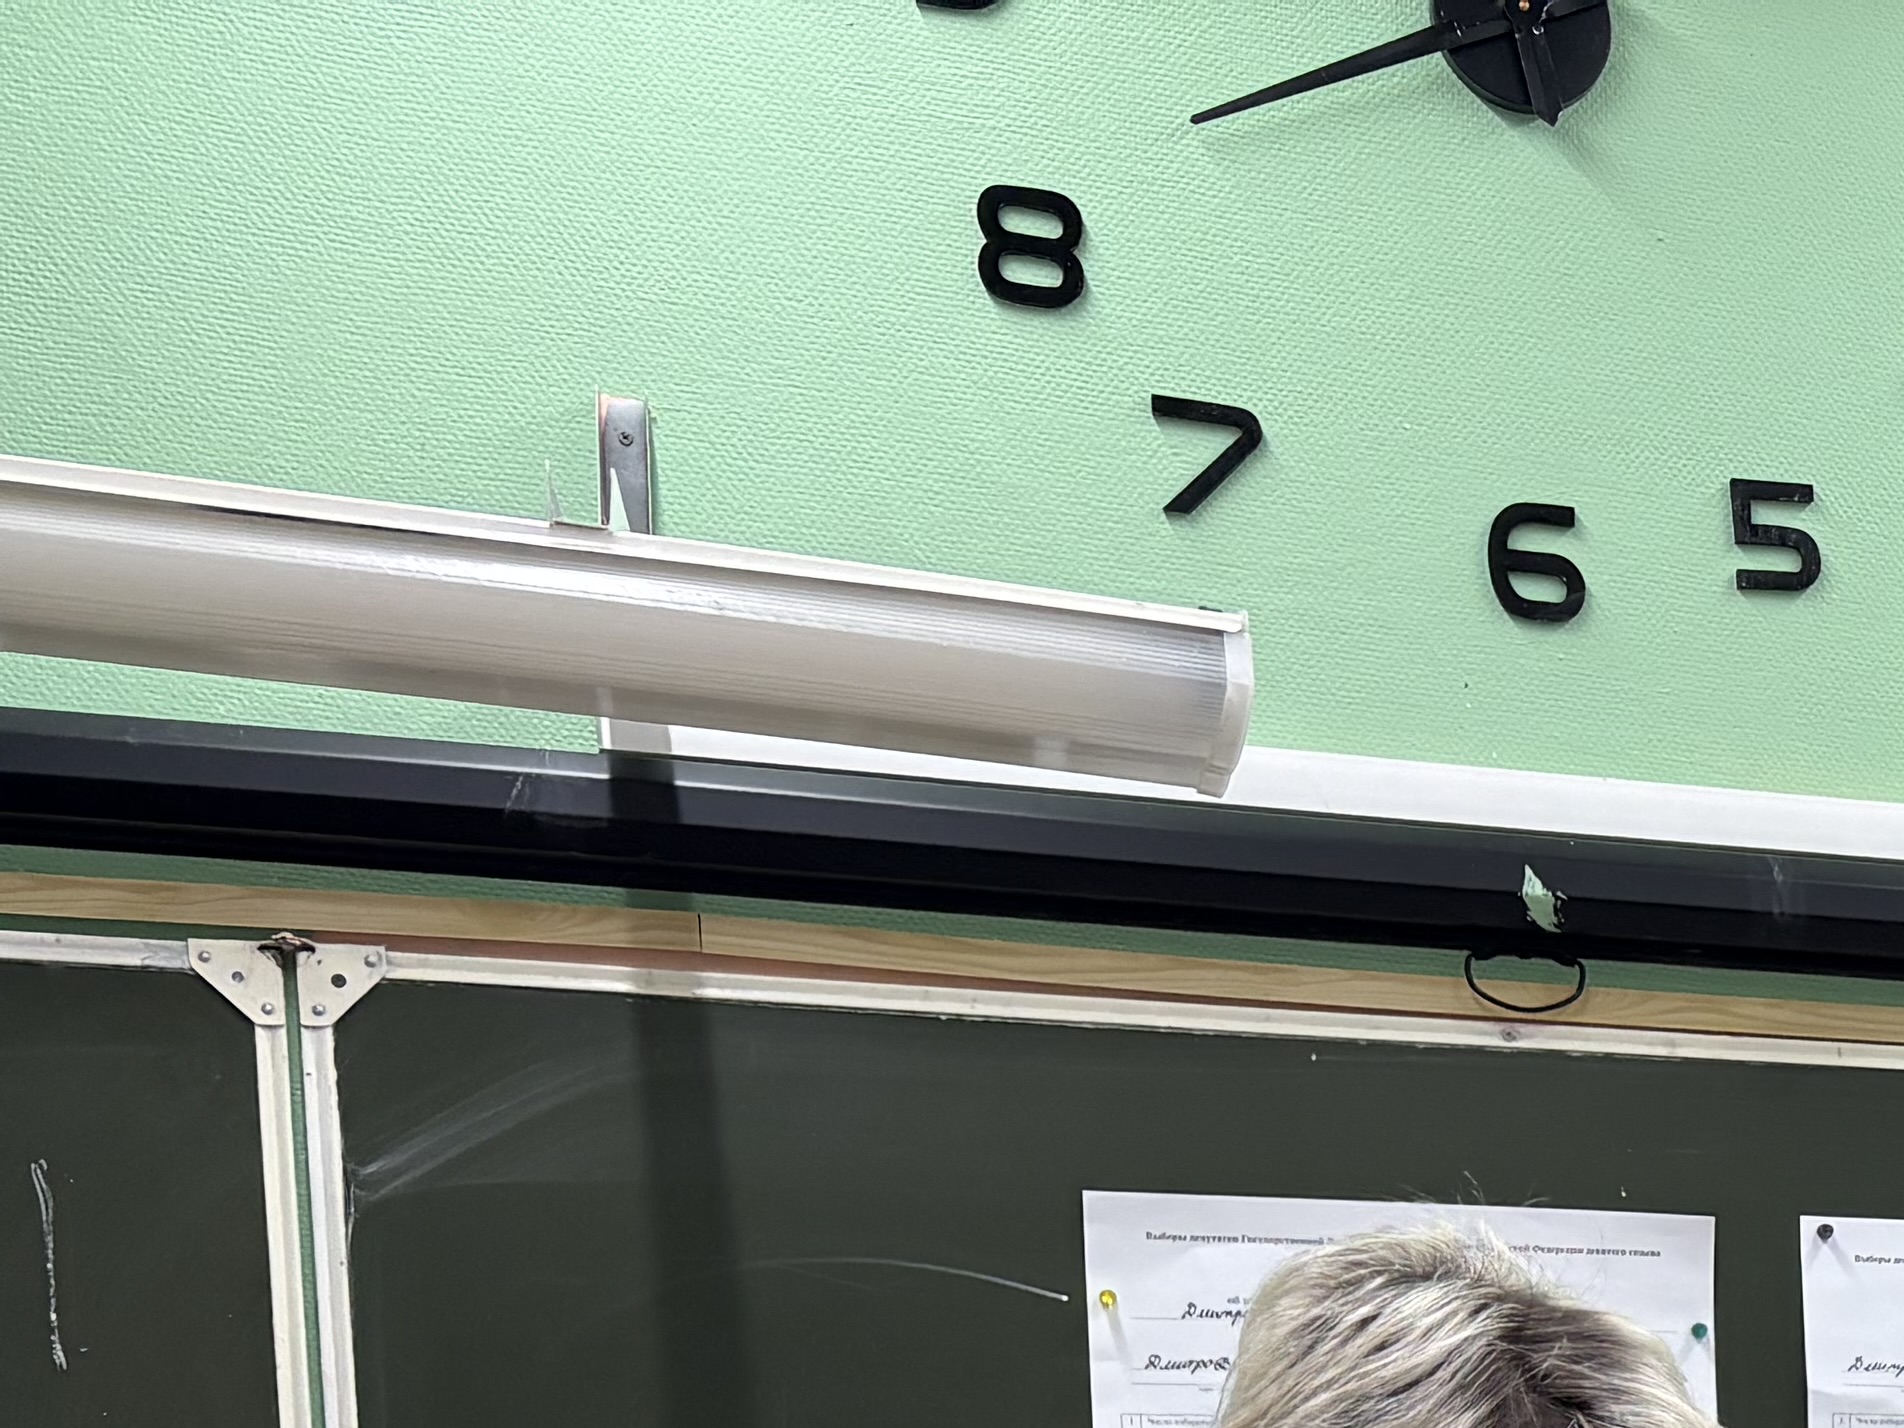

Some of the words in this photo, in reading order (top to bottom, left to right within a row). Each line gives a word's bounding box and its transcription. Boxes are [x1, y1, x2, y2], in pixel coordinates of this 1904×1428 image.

[976, 183, 1087, 312] 8
[1150, 391, 1264, 516] 7
[1487, 501, 1588, 624] 6
[1727, 476, 1822, 592] 5
